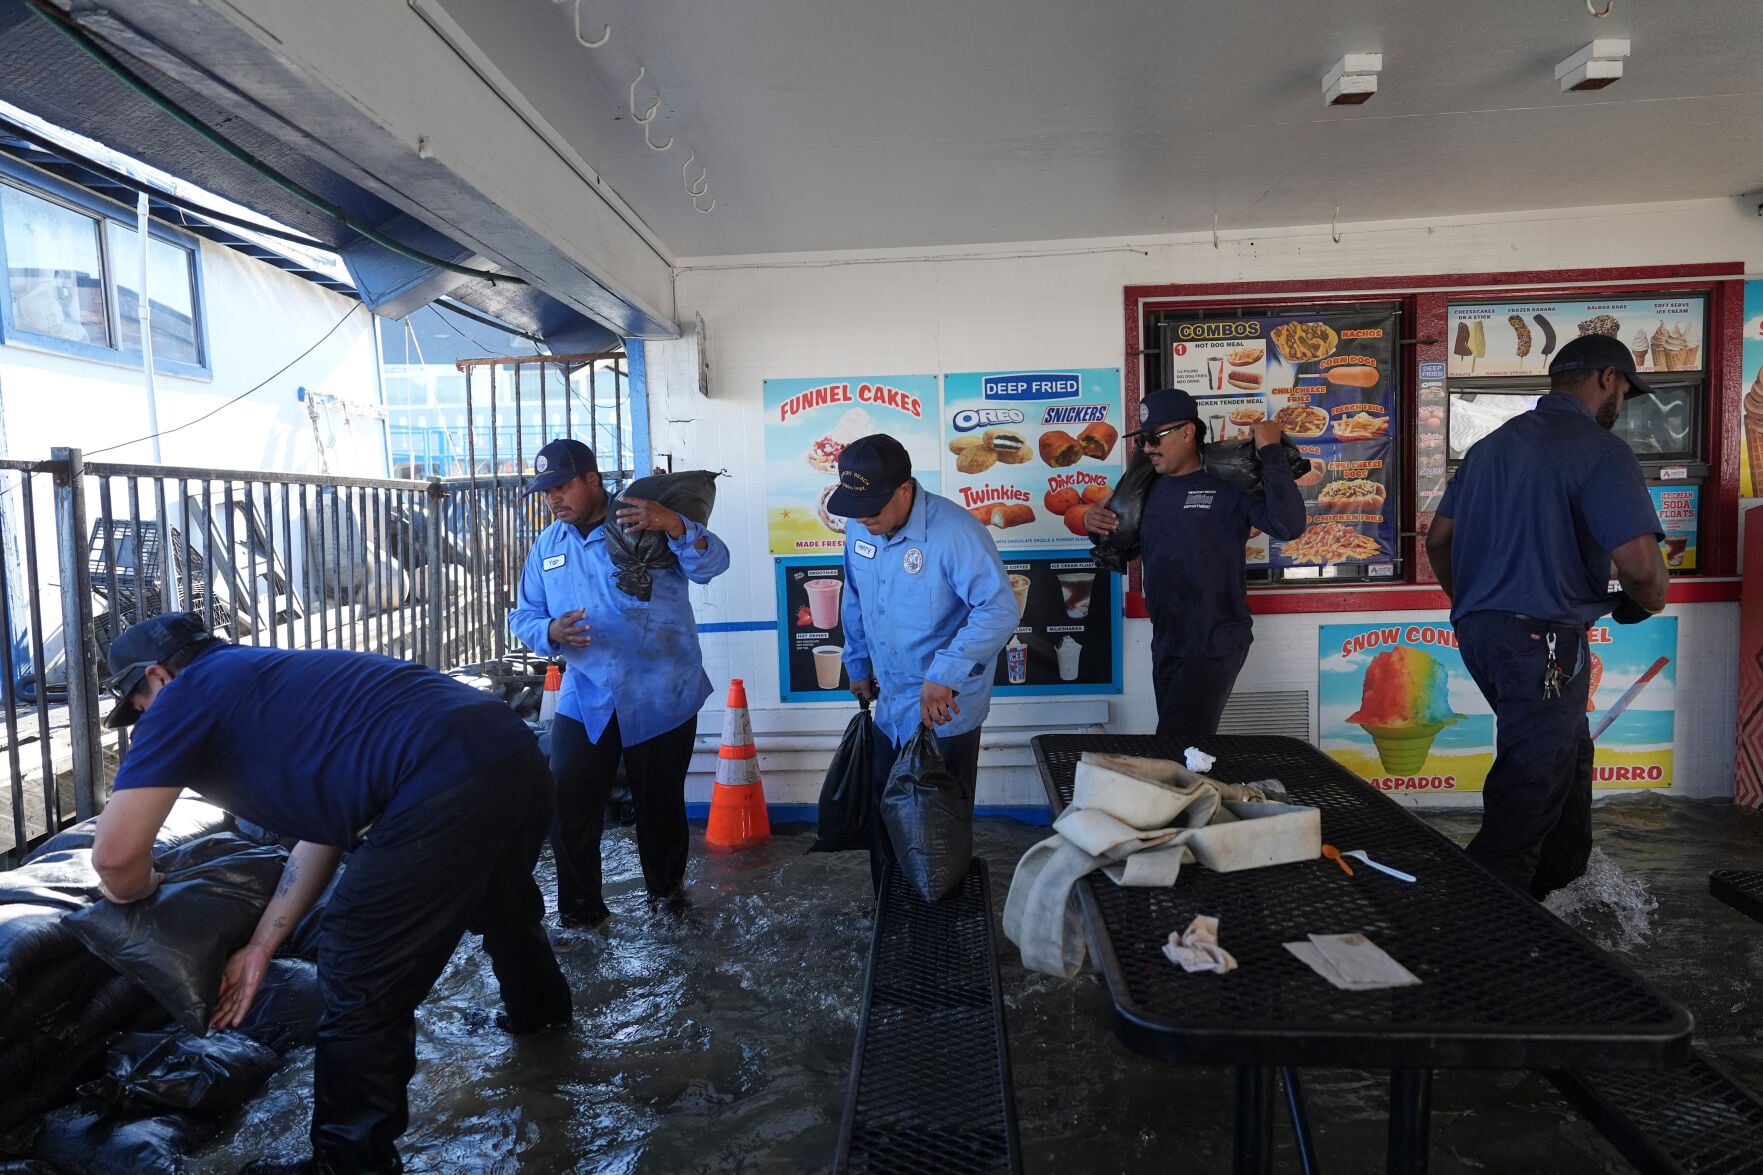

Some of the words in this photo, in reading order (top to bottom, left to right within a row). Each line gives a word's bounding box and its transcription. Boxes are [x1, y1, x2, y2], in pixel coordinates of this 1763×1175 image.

[1179, 321, 1260, 339] COMBOS
[1341, 329, 1382, 339] NACHOS
[1320, 356, 1347, 369] CORN
[1349, 355, 1376, 367] DOGS
[986, 382, 1027, 394] DEEP
[1032, 381, 1077, 393] FRIED
[1272, 387, 1294, 395] CHILI
[1294, 386, 1326, 394] CHEESE
[780, 384, 852, 422] FUNNEL
[858, 384, 921, 417] CAKES
[1331, 404, 1360, 415] FRENCH
[1363, 403, 1384, 414] FRIES
[953, 409, 1024, 432] OREO
[1044, 406, 1106, 423] SNICKERS
[1297, 445, 1320, 454] OGS
[1351, 460, 1382, 469] CHEESE
[1076, 471, 1108, 487] DONGS
[1344, 470, 1368, 478] DOGS
[959, 483, 1031, 508] Twinkies
[1663, 500, 1690, 509] SODA
[1313, 515, 1359, 523] CHICKEN
[1360, 514, 1383, 523] FRIES
[1659, 510, 1694, 518] FLOATS
[1342, 627, 1400, 658] SNOW
[1371, 776, 1455, 790] ASPADOS
